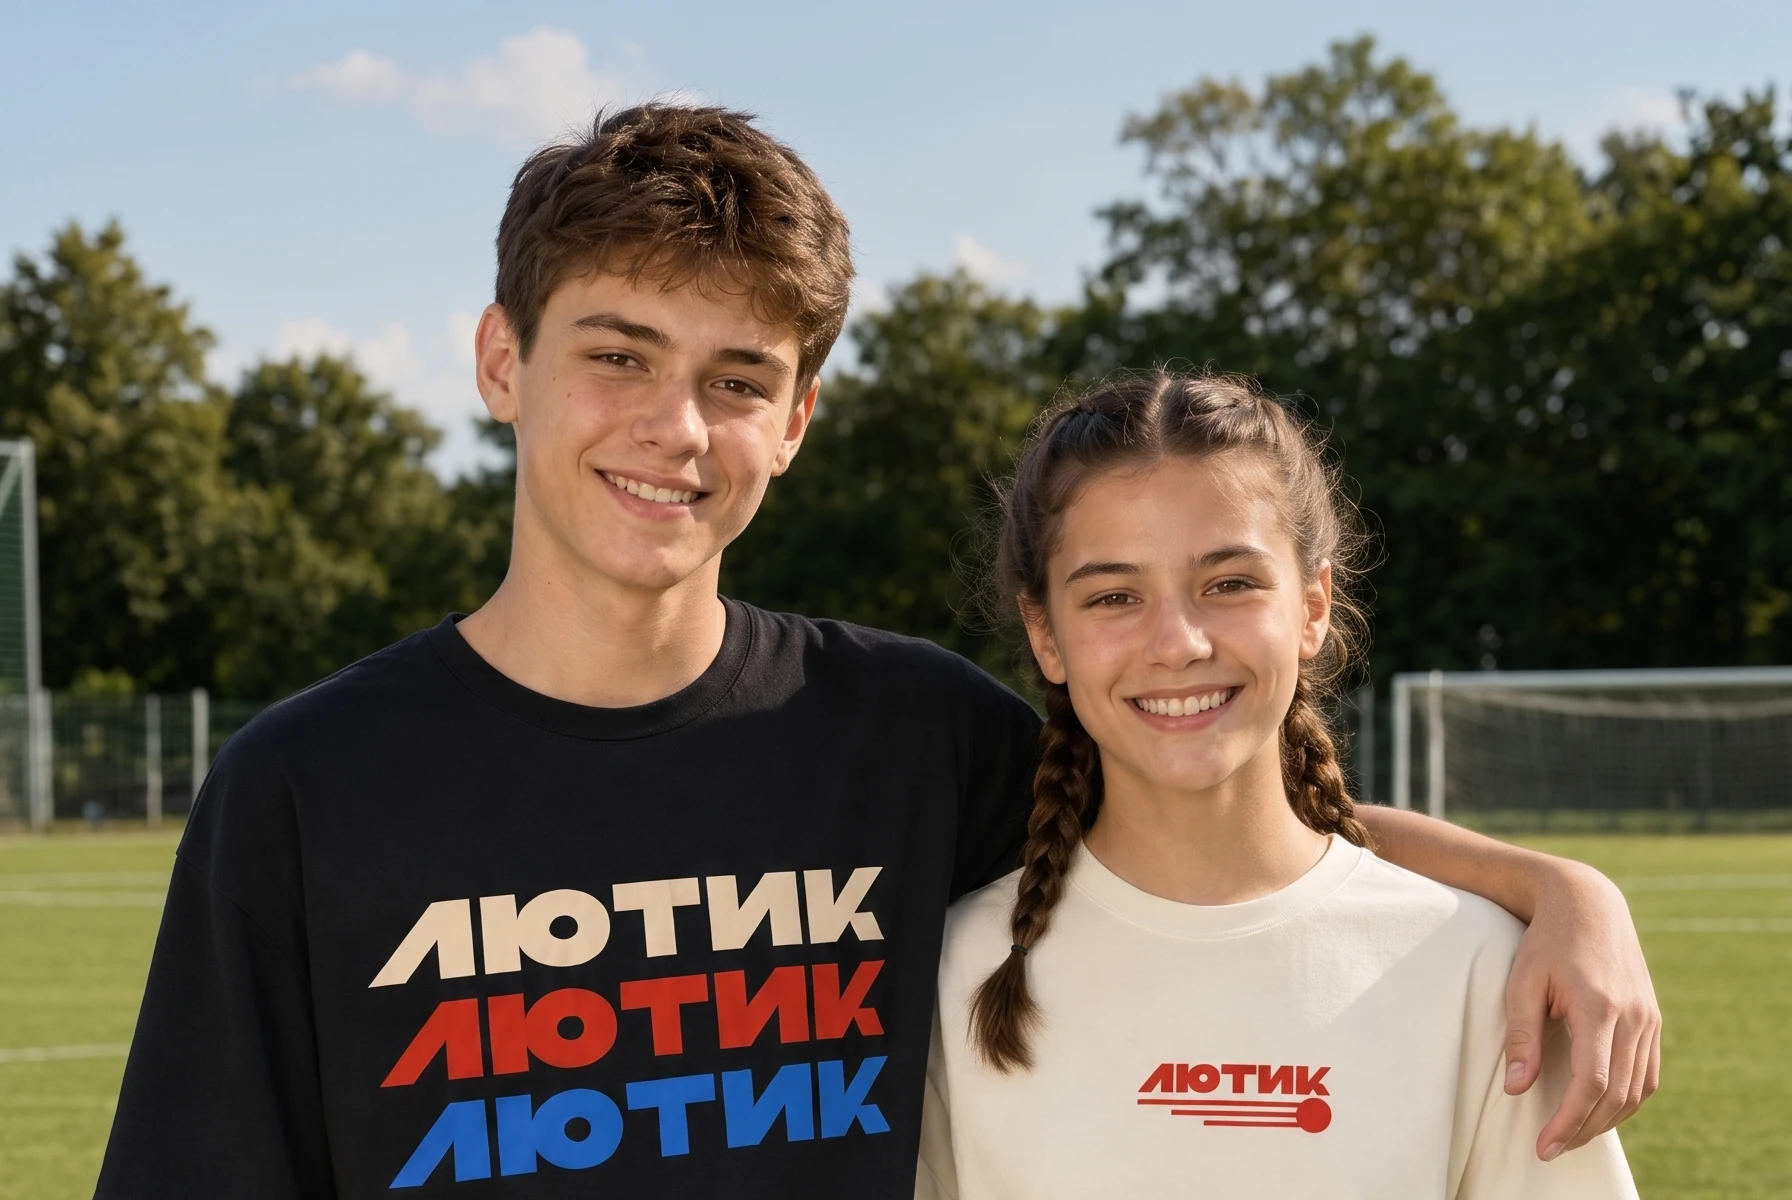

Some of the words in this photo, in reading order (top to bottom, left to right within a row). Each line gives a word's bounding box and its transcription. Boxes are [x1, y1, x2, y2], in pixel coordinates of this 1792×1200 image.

[368, 866, 885, 988] ЛЮТИК
[380, 960, 885, 1088] ЛЮТИК
[1137, 1063, 1332, 1096] ЛЮТИК
[389, 1055, 891, 1189] ЛЮТИК
